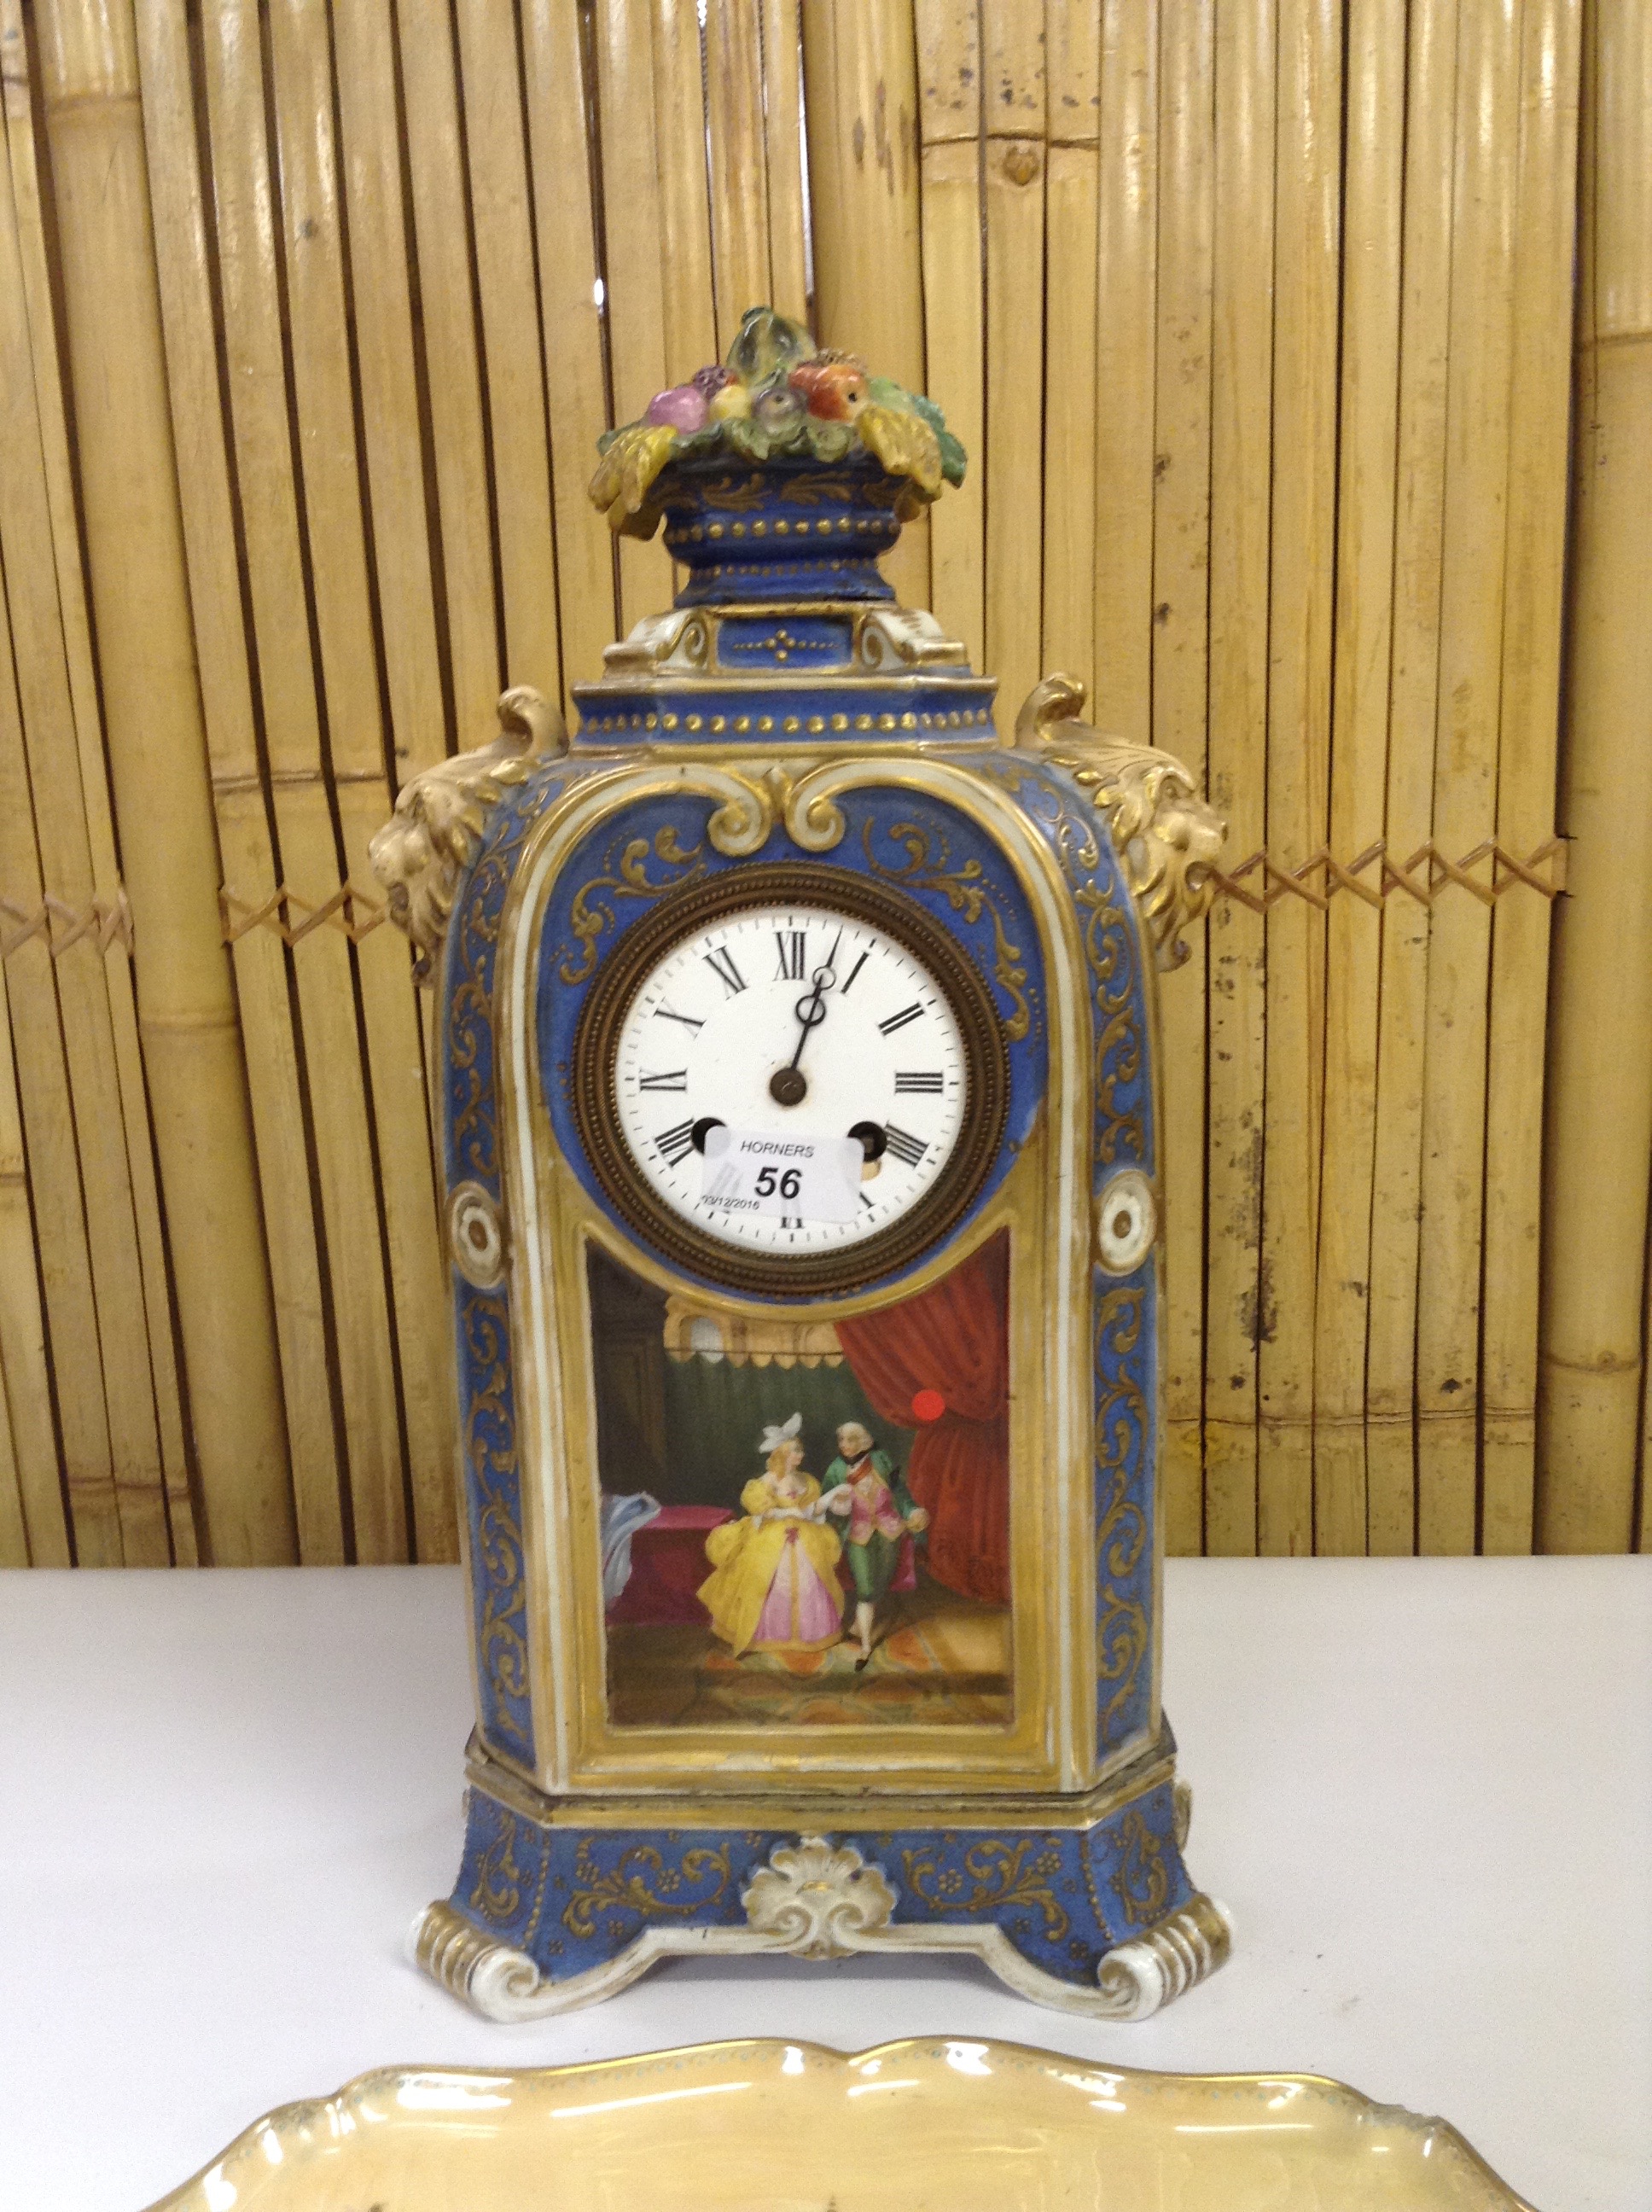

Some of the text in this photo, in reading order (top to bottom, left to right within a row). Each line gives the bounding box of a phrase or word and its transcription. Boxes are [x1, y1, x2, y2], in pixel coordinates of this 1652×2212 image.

[701, 945, 749, 1001] XI
[773, 930, 807, 981] XII
[653, 996, 707, 1040] X
[877, 1001, 926, 1037] II
[639, 1067, 689, 1093] IX
[893, 1070, 944, 1095] III
[740, 1140, 815, 1158] HORNERS
[754, 1166, 803, 1200] 56
